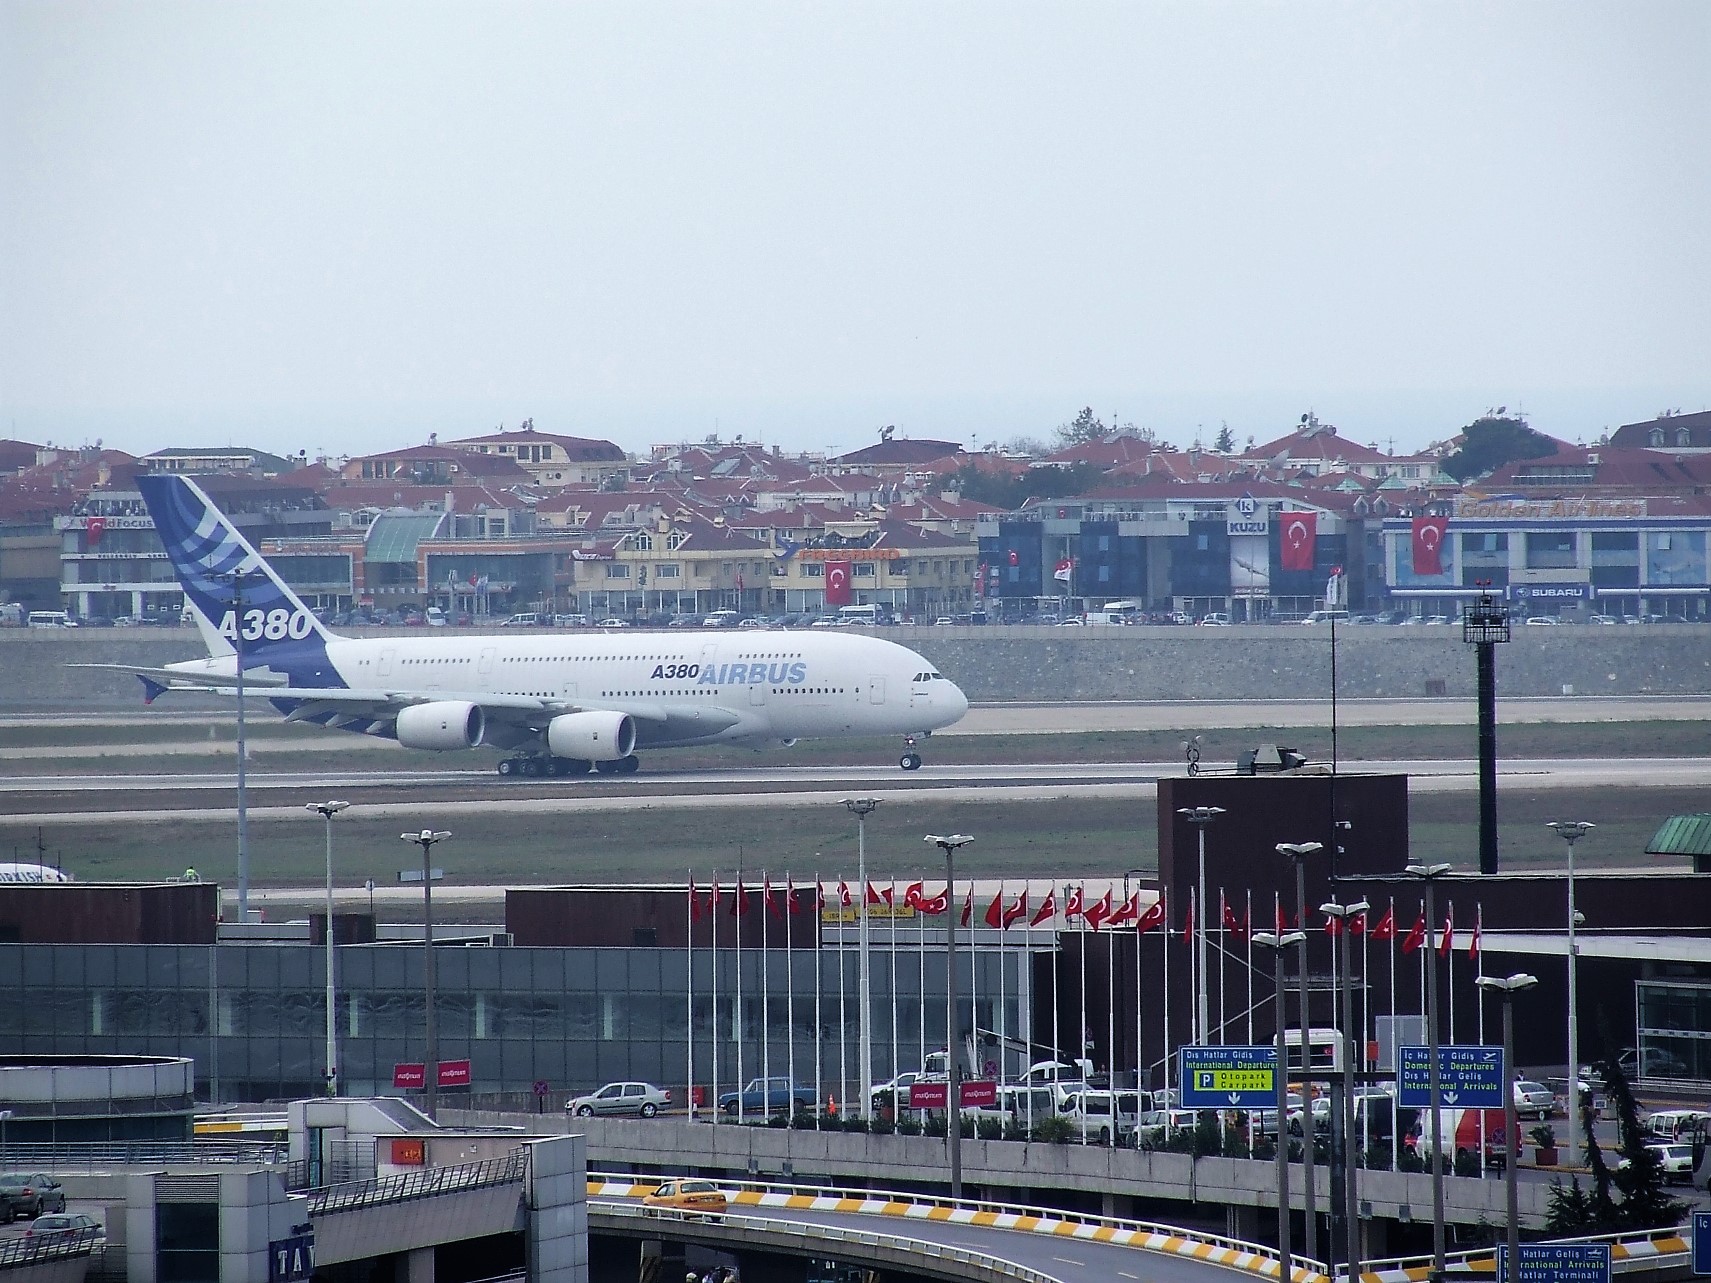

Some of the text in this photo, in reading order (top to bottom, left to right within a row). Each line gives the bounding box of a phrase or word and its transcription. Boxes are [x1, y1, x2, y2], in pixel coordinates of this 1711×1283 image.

[1459, 501, 1540, 517] Golden
[1230, 522, 1266, 532] KUZU
[1532, 588, 1583, 597] SUBARU
[219, 608, 313, 640] A380
[650, 662, 807, 685] A380 AIRBUS
[1203, 1051, 1228, 1059] Hatlar
[1418, 1052, 1445, 1060] Har
[1186, 1061, 1233, 1069] International
[1404, 1062, 1495, 1072] Domesc Departures
[1203, 1073, 1265, 1087] P Otopark
[1423, 1072, 1451, 1080] Hlar
[1221, 1081, 1265, 1090] Carpark
[1404, 1082, 1498, 1090] Internaonal Arrivals
[1523, 1250, 1550, 1258] Hatlar
[1504, 1261, 1605, 1269] Inrnational Arrivals
[1553, 1271, 1599, 1279] Terminali
